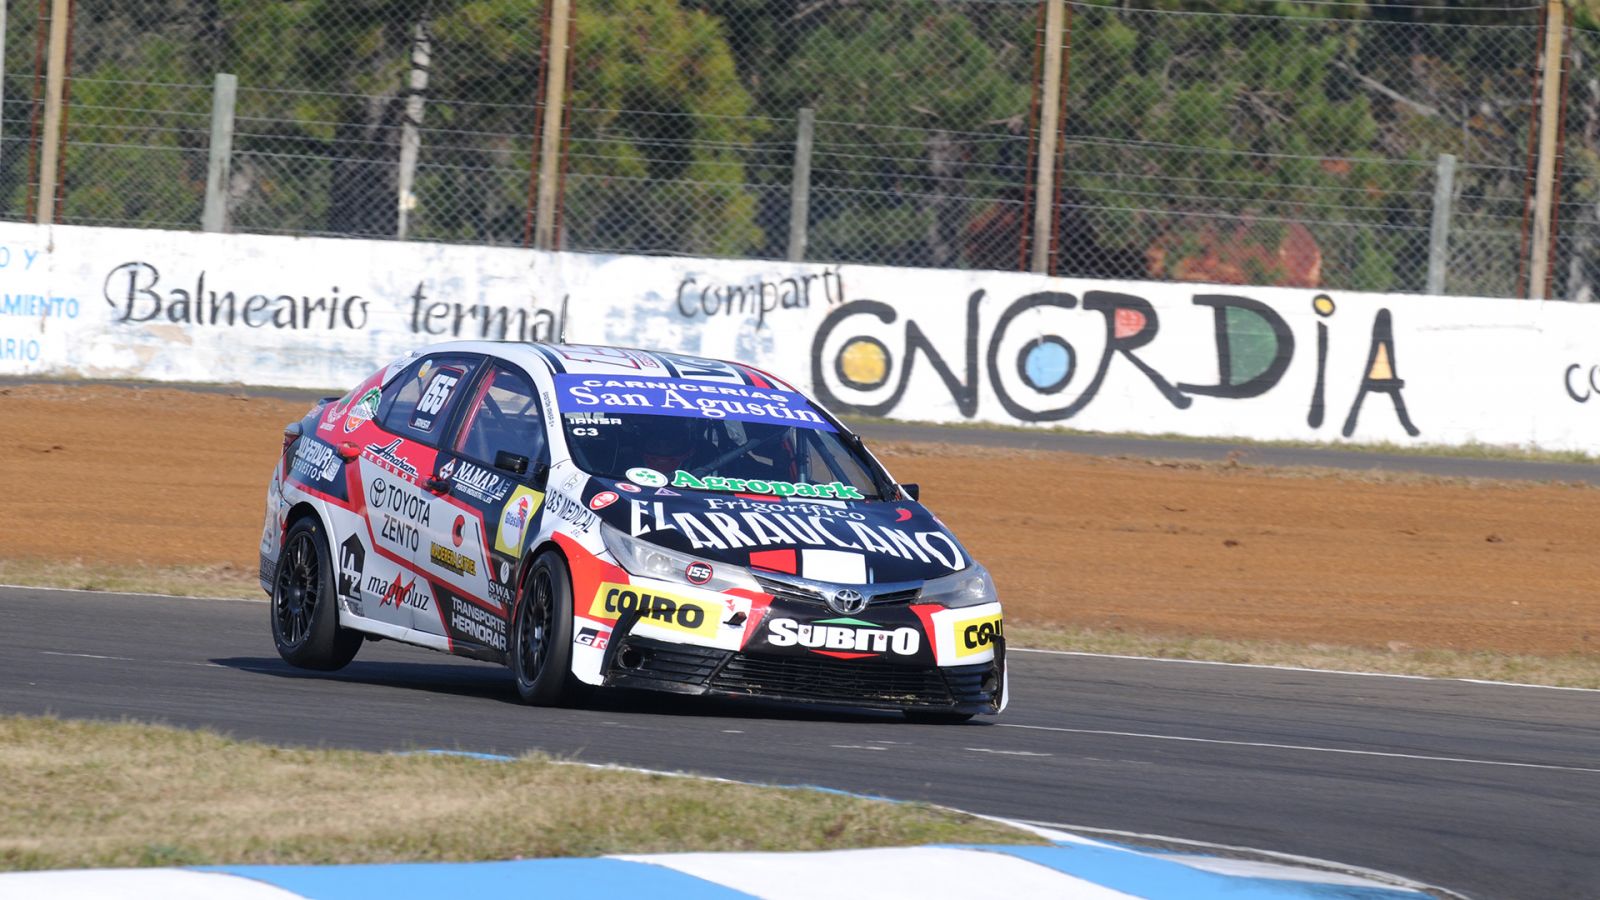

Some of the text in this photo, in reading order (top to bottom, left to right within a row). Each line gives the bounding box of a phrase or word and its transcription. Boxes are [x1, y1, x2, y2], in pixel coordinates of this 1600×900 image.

[24, 249, 39, 270] Y
[104, 261, 570, 344] Balneario termal
[416, 373, 458, 415] 155
[568, 386, 656, 407] San
[572, 427, 600, 437] C3
[361, 450, 416, 485] SEGUROS
[365, 438, 419, 479] Abraham
[453, 460, 504, 498] NAMARA
[671, 470, 866, 500] Agropark
[387, 484, 431, 528] TOYOTA
[560, 496, 597, 534] MEDICAL
[381, 513, 420, 552] ZENTO
[631, 499, 966, 571] EL ARAUCANO
[688, 565, 712, 579] 155
[367, 576, 430, 611] magnoluz
[604, 588, 705, 629] COIRO
[451, 596, 506, 634] TRANSPORTE
[451, 611, 507, 652] HERNORAR
[575, 633, 609, 649] GR
[767, 617, 921, 656] SUBITO
